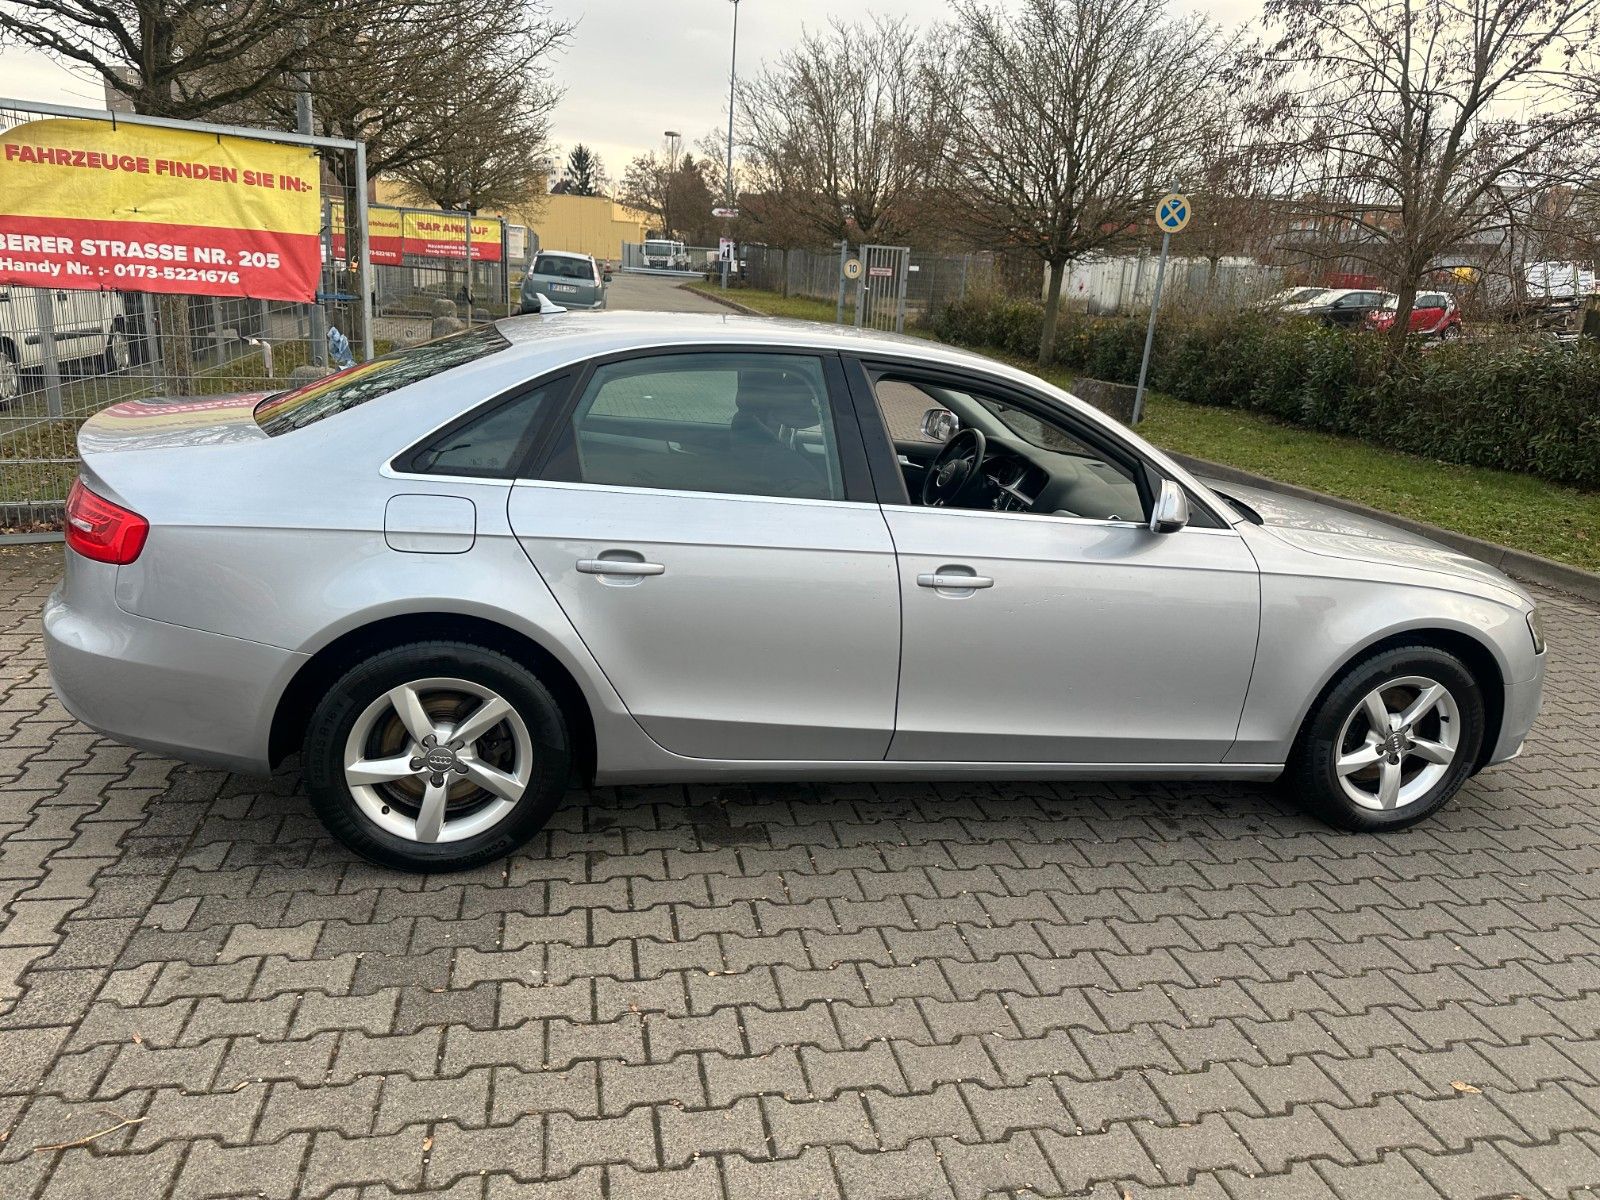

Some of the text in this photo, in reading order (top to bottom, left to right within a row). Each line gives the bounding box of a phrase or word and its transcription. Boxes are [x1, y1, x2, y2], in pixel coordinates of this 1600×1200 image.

[4, 143, 149, 174] FAHRZEUGE
[155, 159, 238, 183] FINDEN
[243, 170, 275, 189] SIE
[416, 221, 440, 232] BAR
[80, 239, 188, 262] STRASSE
[193, 247, 233, 266] NR.
[238, 250, 281, 269] 205
[0, 256, 61, 276] Handy
[66, 261, 93, 276] Nr.
[114, 263, 240, 285] 0173-5221676
[849, 264, 858, 274] 10
